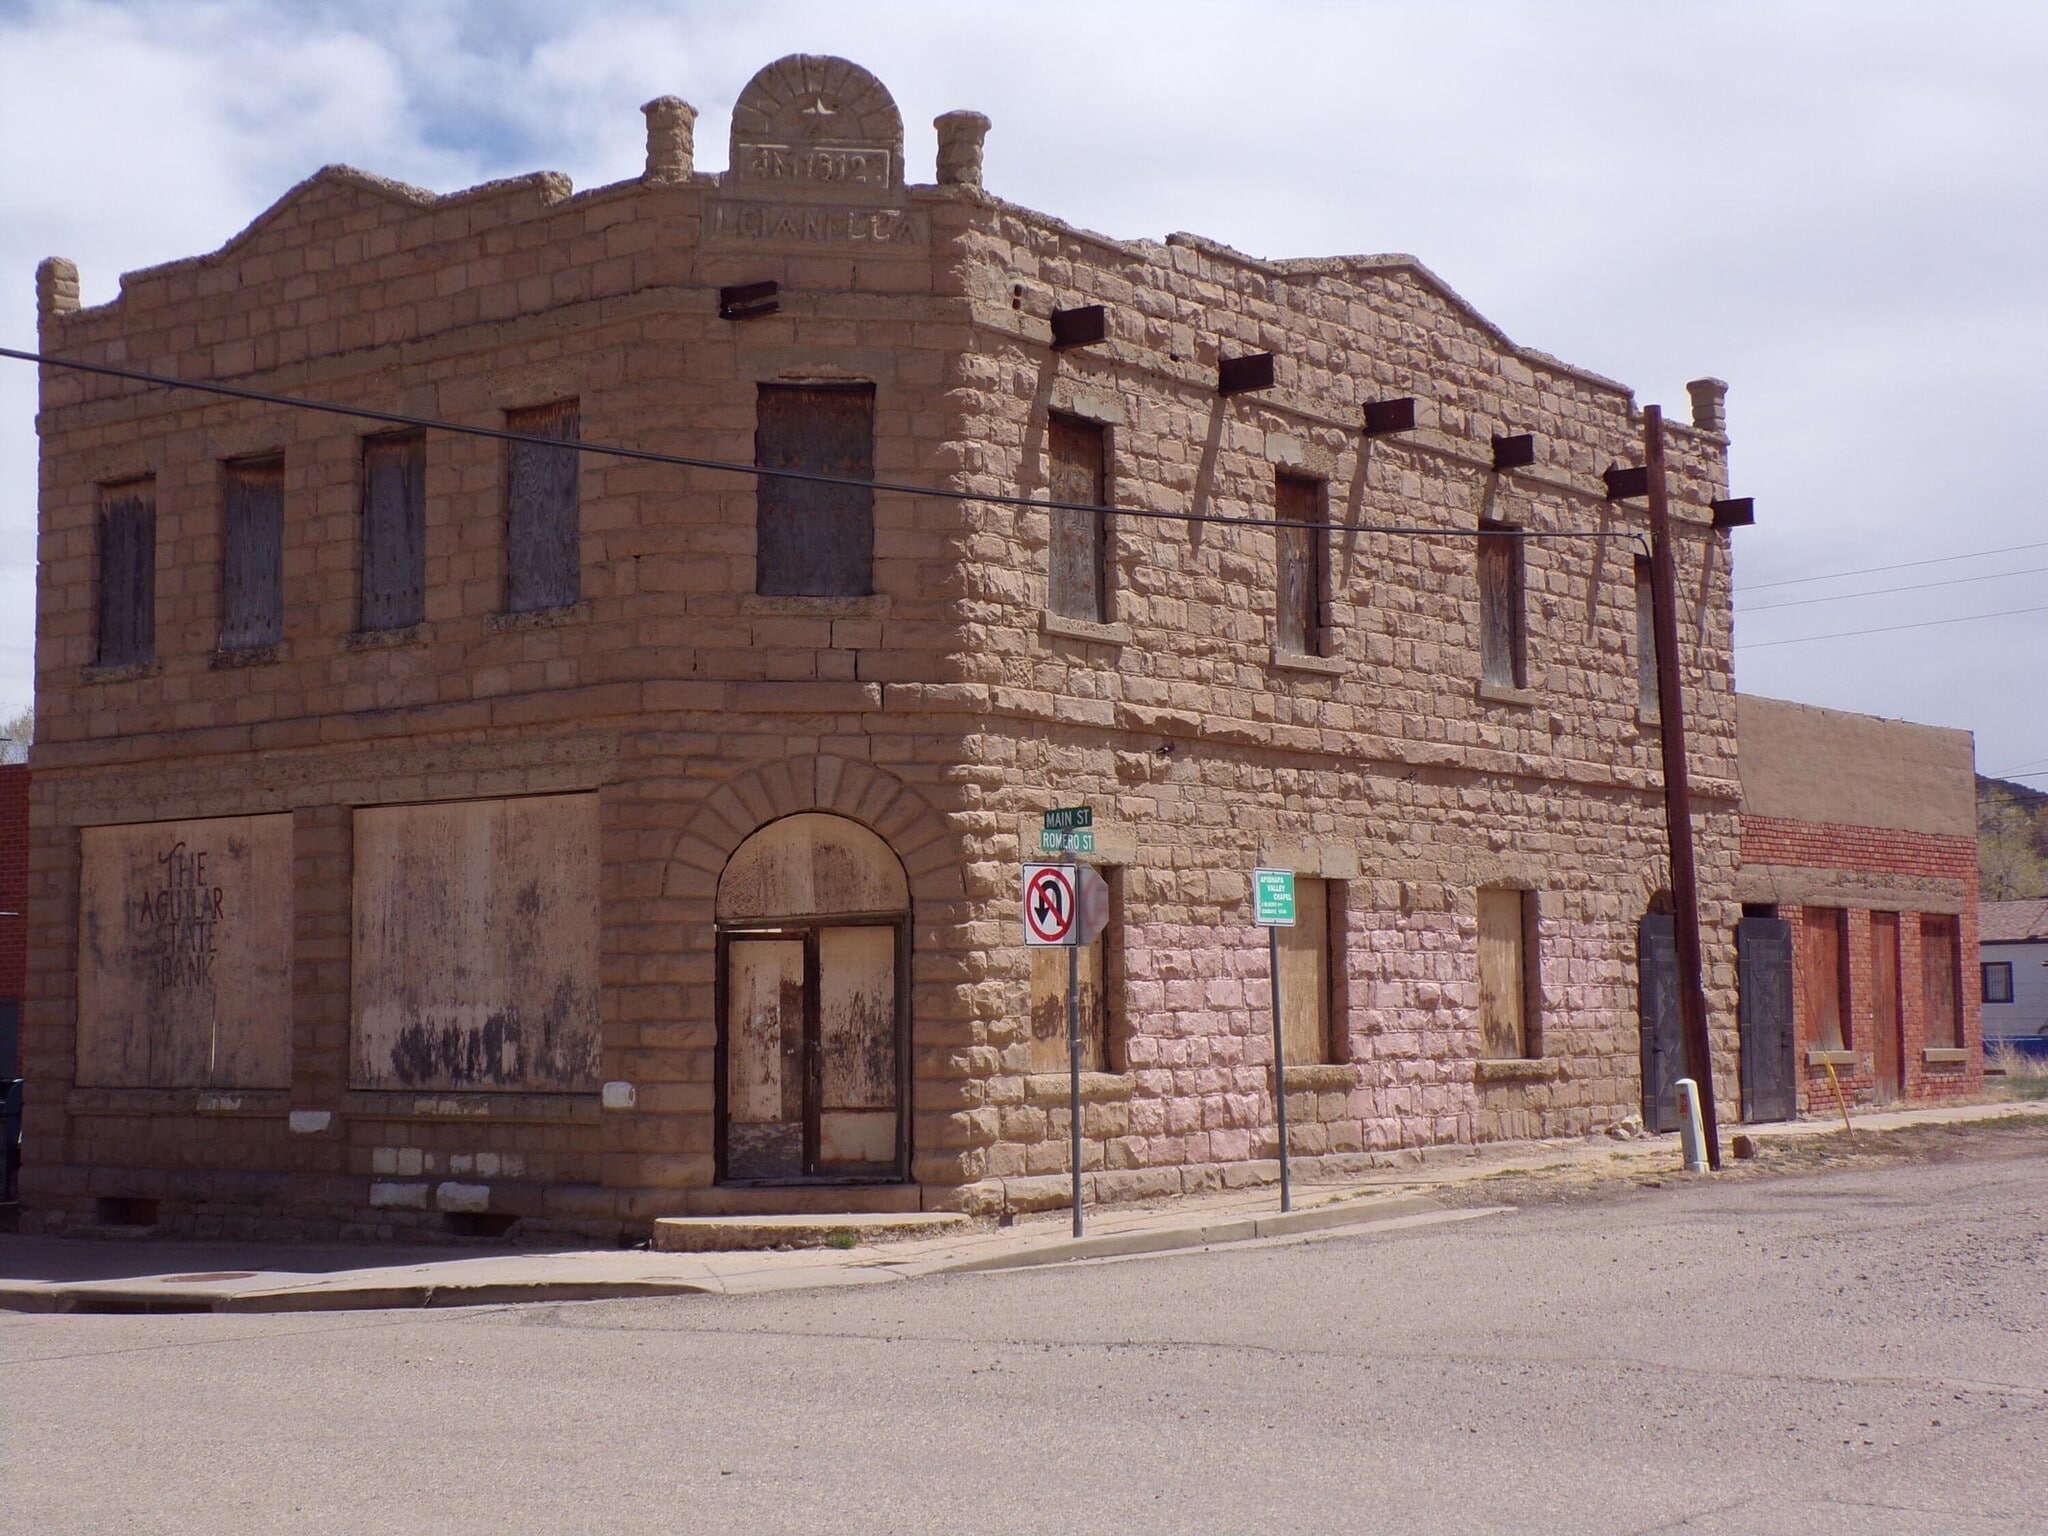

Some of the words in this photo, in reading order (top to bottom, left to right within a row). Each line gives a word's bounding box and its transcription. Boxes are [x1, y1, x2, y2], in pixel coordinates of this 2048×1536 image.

[1046, 811, 1072, 828] MAIN
[1077, 809, 1089, 825] ST
[1042, 832, 1080, 850] ROMERO
[1082, 834, 1092, 850] ST
[158, 841, 208, 887] THE
[1267, 884, 1285, 892] VALLEY
[1273, 893, 1292, 901] CHAPEL
[140, 887, 224, 924] AGUILAR
[155, 921, 218, 954] STATE
[161, 954, 216, 991] BANK
